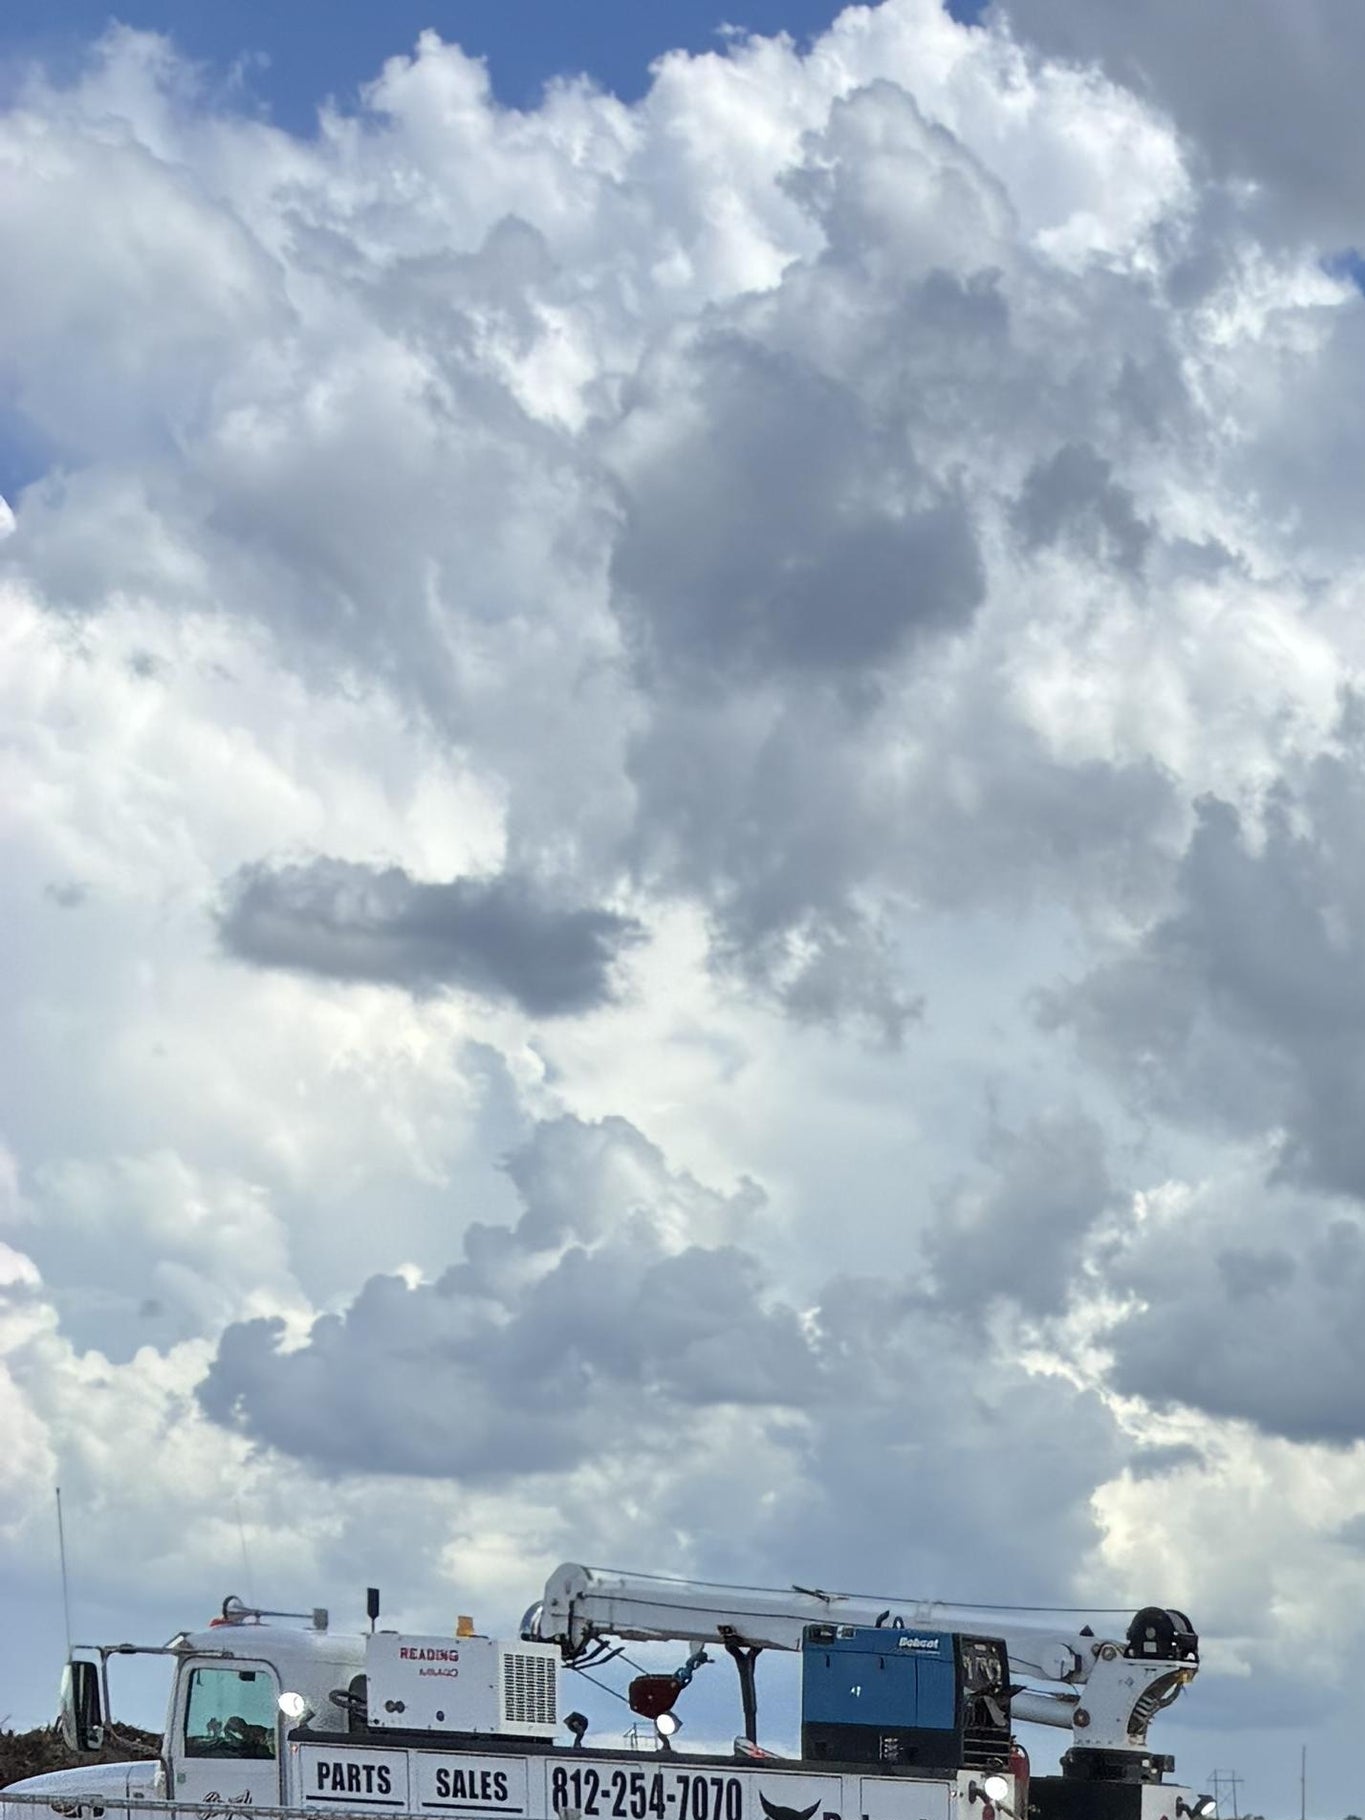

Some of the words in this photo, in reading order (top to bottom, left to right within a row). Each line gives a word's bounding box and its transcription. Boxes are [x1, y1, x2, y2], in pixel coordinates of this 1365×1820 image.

[399, 1647, 459, 1662] READING
[317, 1761, 392, 1795] PARTS
[435, 1767, 509, 1801] SALES
